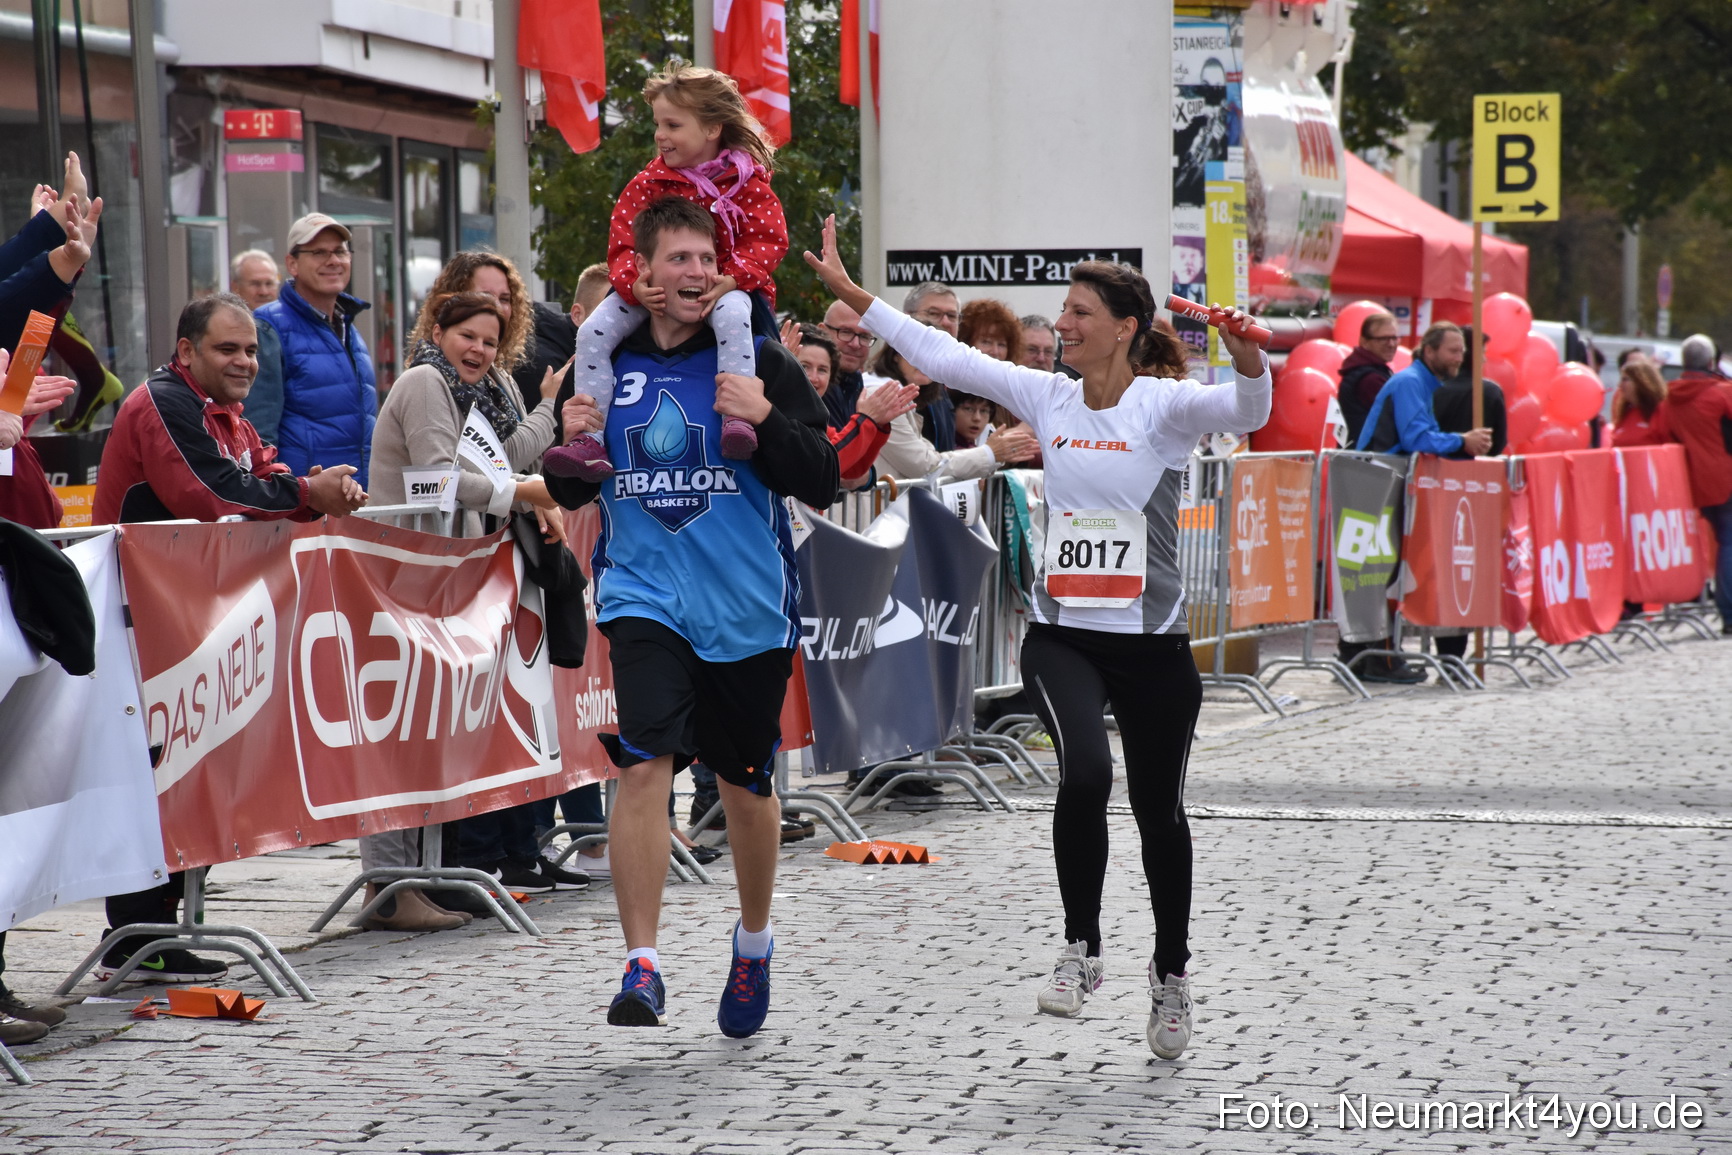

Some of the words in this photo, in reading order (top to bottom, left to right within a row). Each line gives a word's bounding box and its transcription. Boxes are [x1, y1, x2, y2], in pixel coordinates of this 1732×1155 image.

[1484, 100, 1549, 123] Block
[238, 154, 275, 166] HotSpot
[1496, 133, 1538, 193] B
[1181, 307, 1210, 324] 8017
[462, 425, 497, 459] swn
[1070, 438, 1133, 452] KLEBL
[411, 481, 439, 495] swn
[615, 468, 738, 497] FIBALON
[646, 497, 699, 508] BASKETS
[1081, 518, 1117, 527] BOCK
[1058, 539, 1131, 569] 8017
[148, 672, 208, 771] DAS
[215, 614, 266, 726] NEUE
